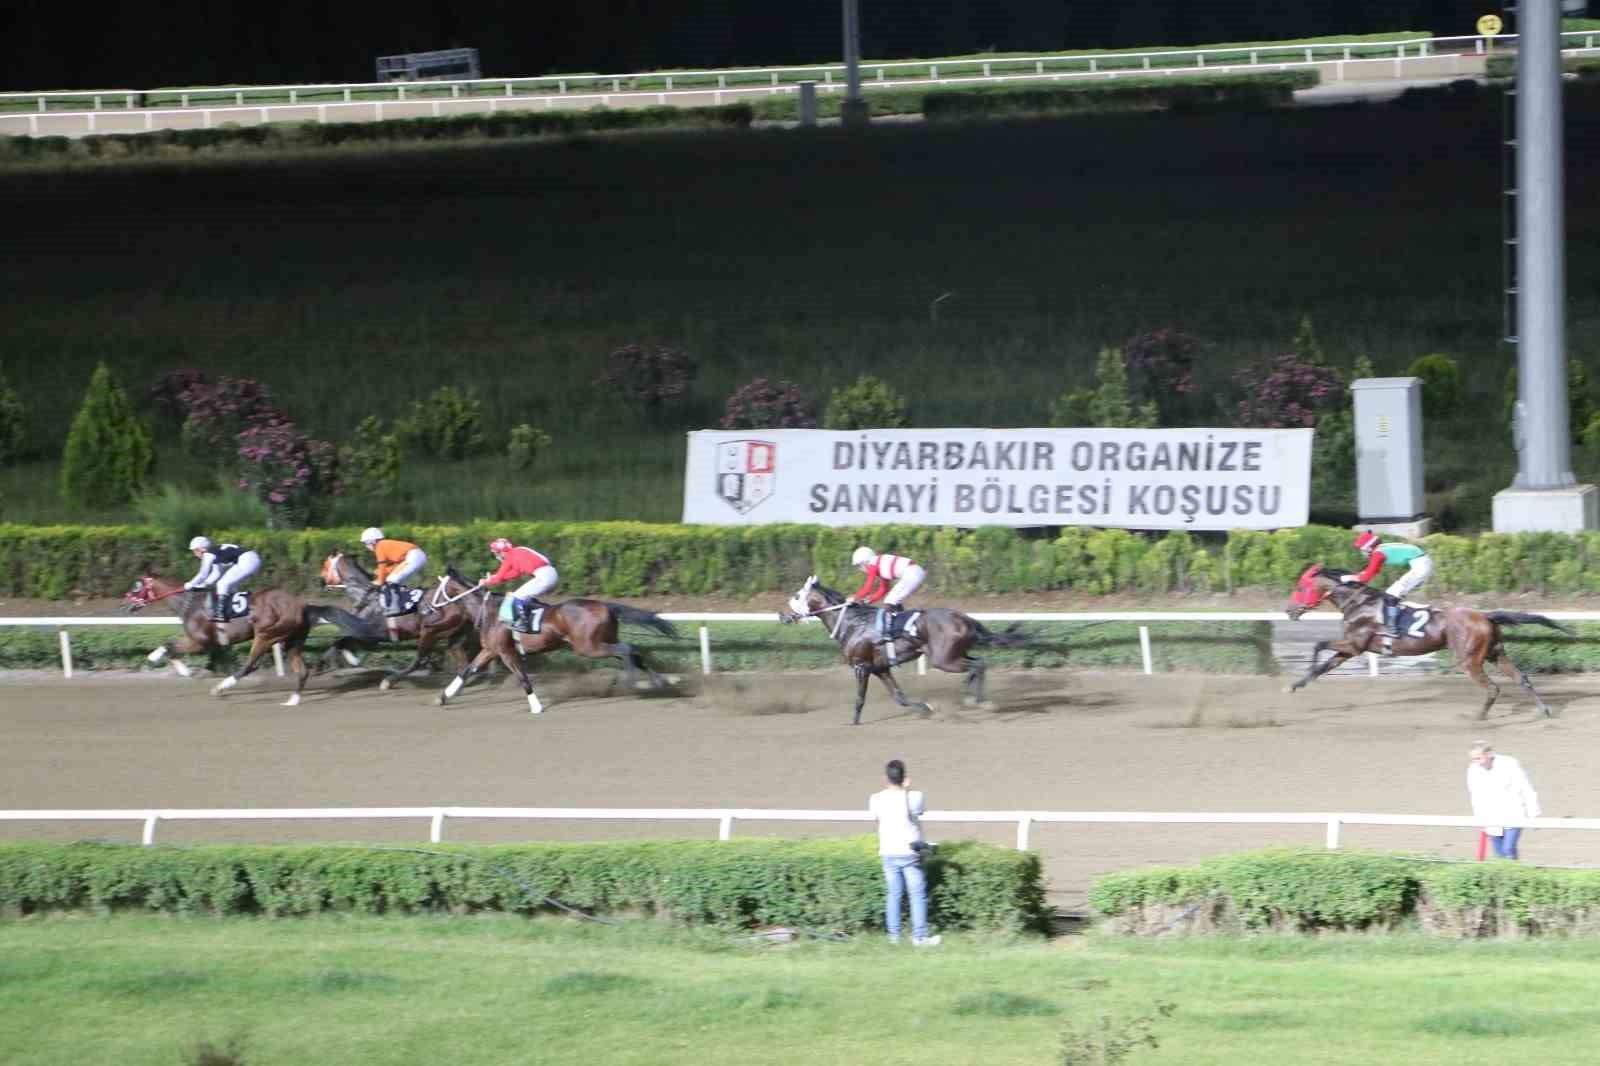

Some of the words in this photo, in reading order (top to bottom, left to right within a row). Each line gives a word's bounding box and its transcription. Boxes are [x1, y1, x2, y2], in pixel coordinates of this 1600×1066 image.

[833, 434, 1054, 471] DİYARBAKIR
[1071, 434, 1262, 472] ORGANİZE
[810, 477, 938, 513] SANAYİ
[954, 477, 1111, 515] BÖLGESİ
[1128, 484, 1281, 524] KOŞUSU
[231, 591, 247, 613] 5
[531, 607, 545, 631] 1
[1407, 609, 1431, 637] 2
